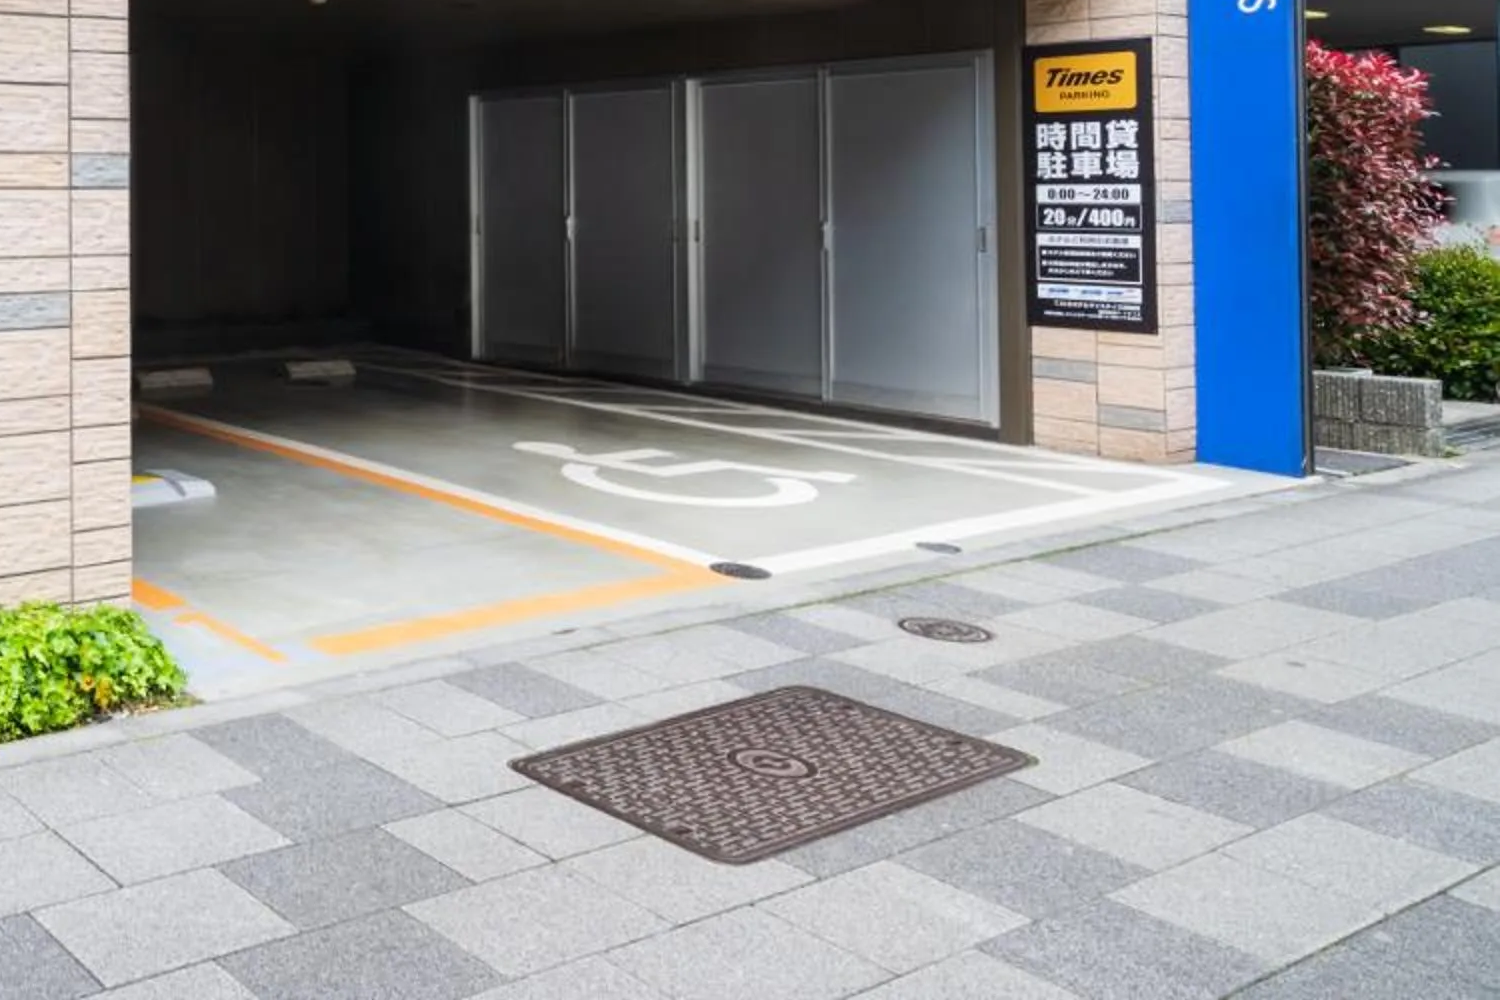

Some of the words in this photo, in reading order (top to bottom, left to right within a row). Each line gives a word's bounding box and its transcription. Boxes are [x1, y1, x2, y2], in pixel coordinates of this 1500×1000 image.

[1046, 67, 1125, 88] Times
[1059, 90, 1111, 101] PARKING
[1036, 120, 1139, 150] 時間貸
[1037, 151, 1140, 180] 駐車場
